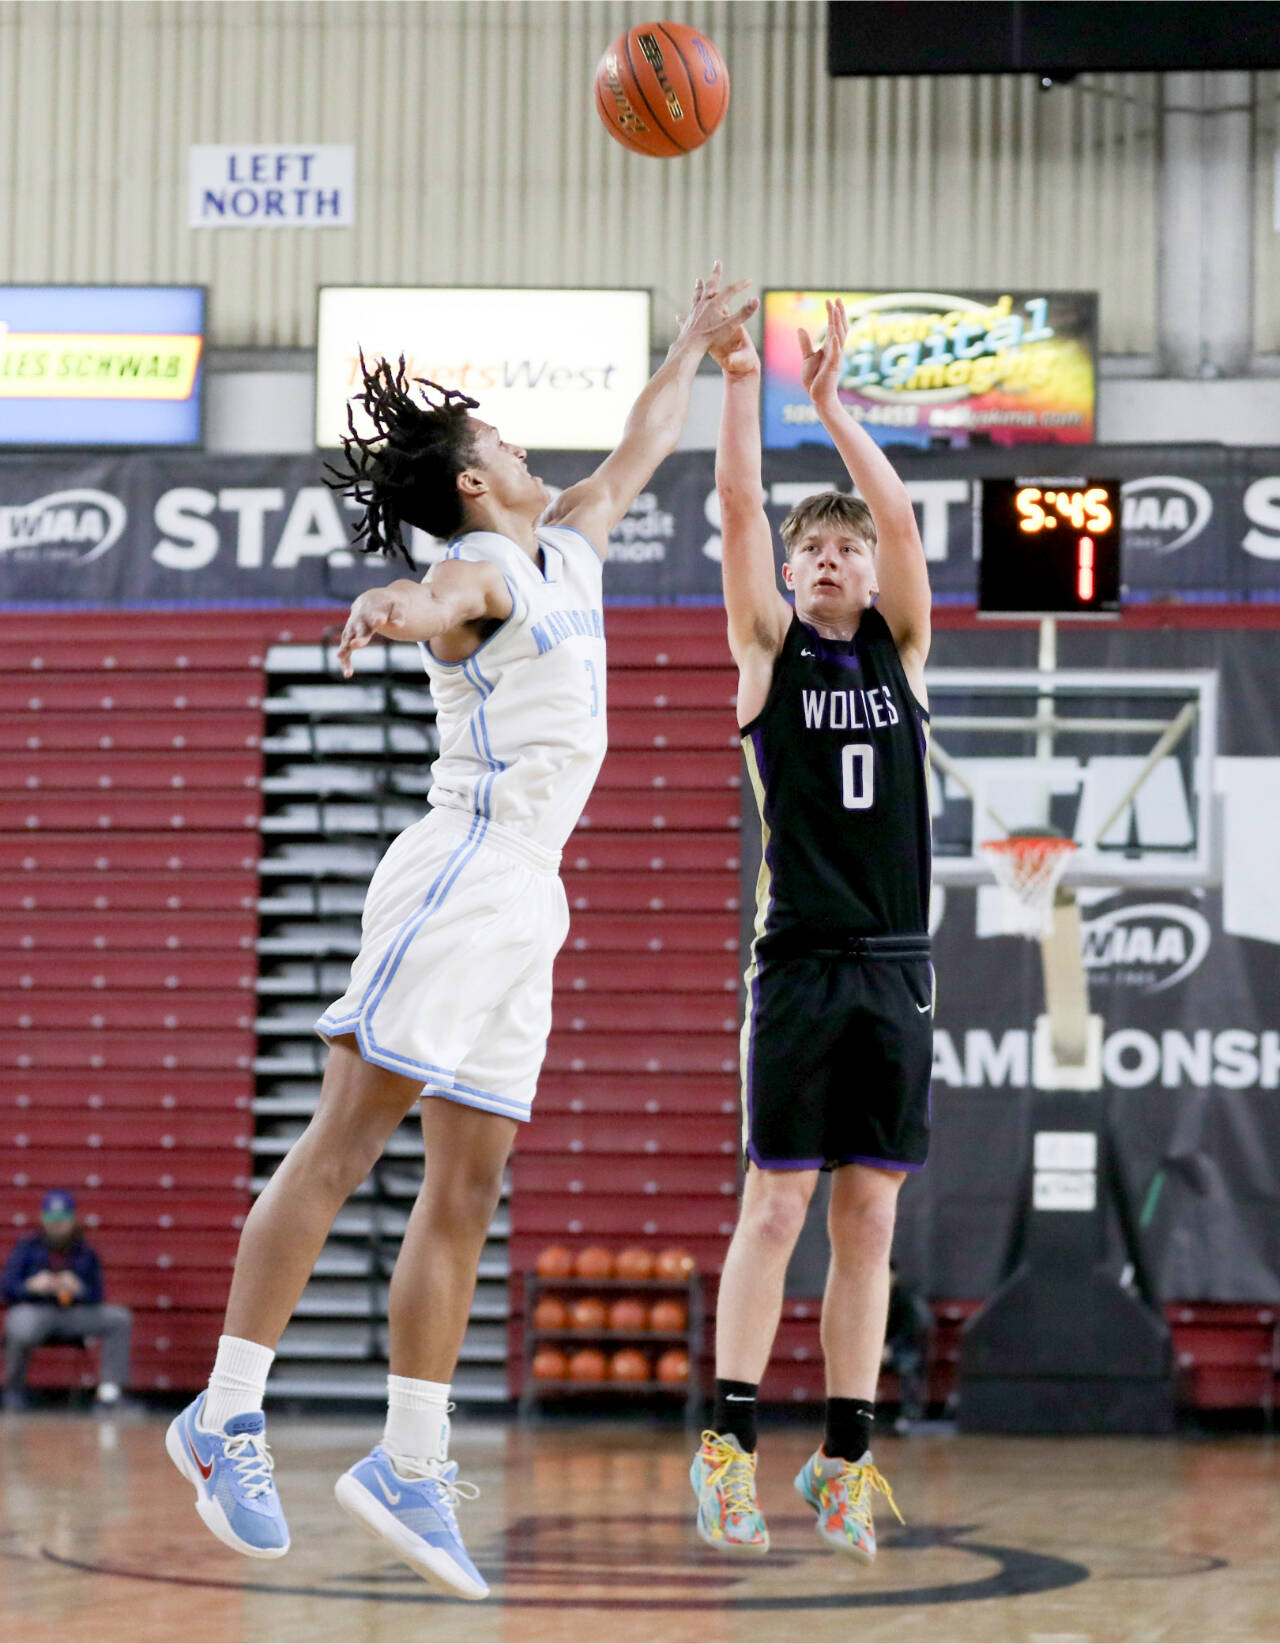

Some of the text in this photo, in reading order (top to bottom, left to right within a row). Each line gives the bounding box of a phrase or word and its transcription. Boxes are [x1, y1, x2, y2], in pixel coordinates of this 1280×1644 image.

[228, 153, 316, 183] LEFT
[202, 187, 341, 218] NORTH
[838, 298, 1055, 388] igital
[2, 353, 182, 378] LES SCHWAB
[345, 352, 617, 390] TketsWest
[9, 508, 105, 544] WIAA
[1015, 487, 1113, 533] 5:45
[1121, 497, 1188, 531] IAA
[152, 487, 450, 571] STA
[606, 541, 665, 563] nion
[1077, 536, 1095, 601] 1
[842, 744, 874, 809] 0
